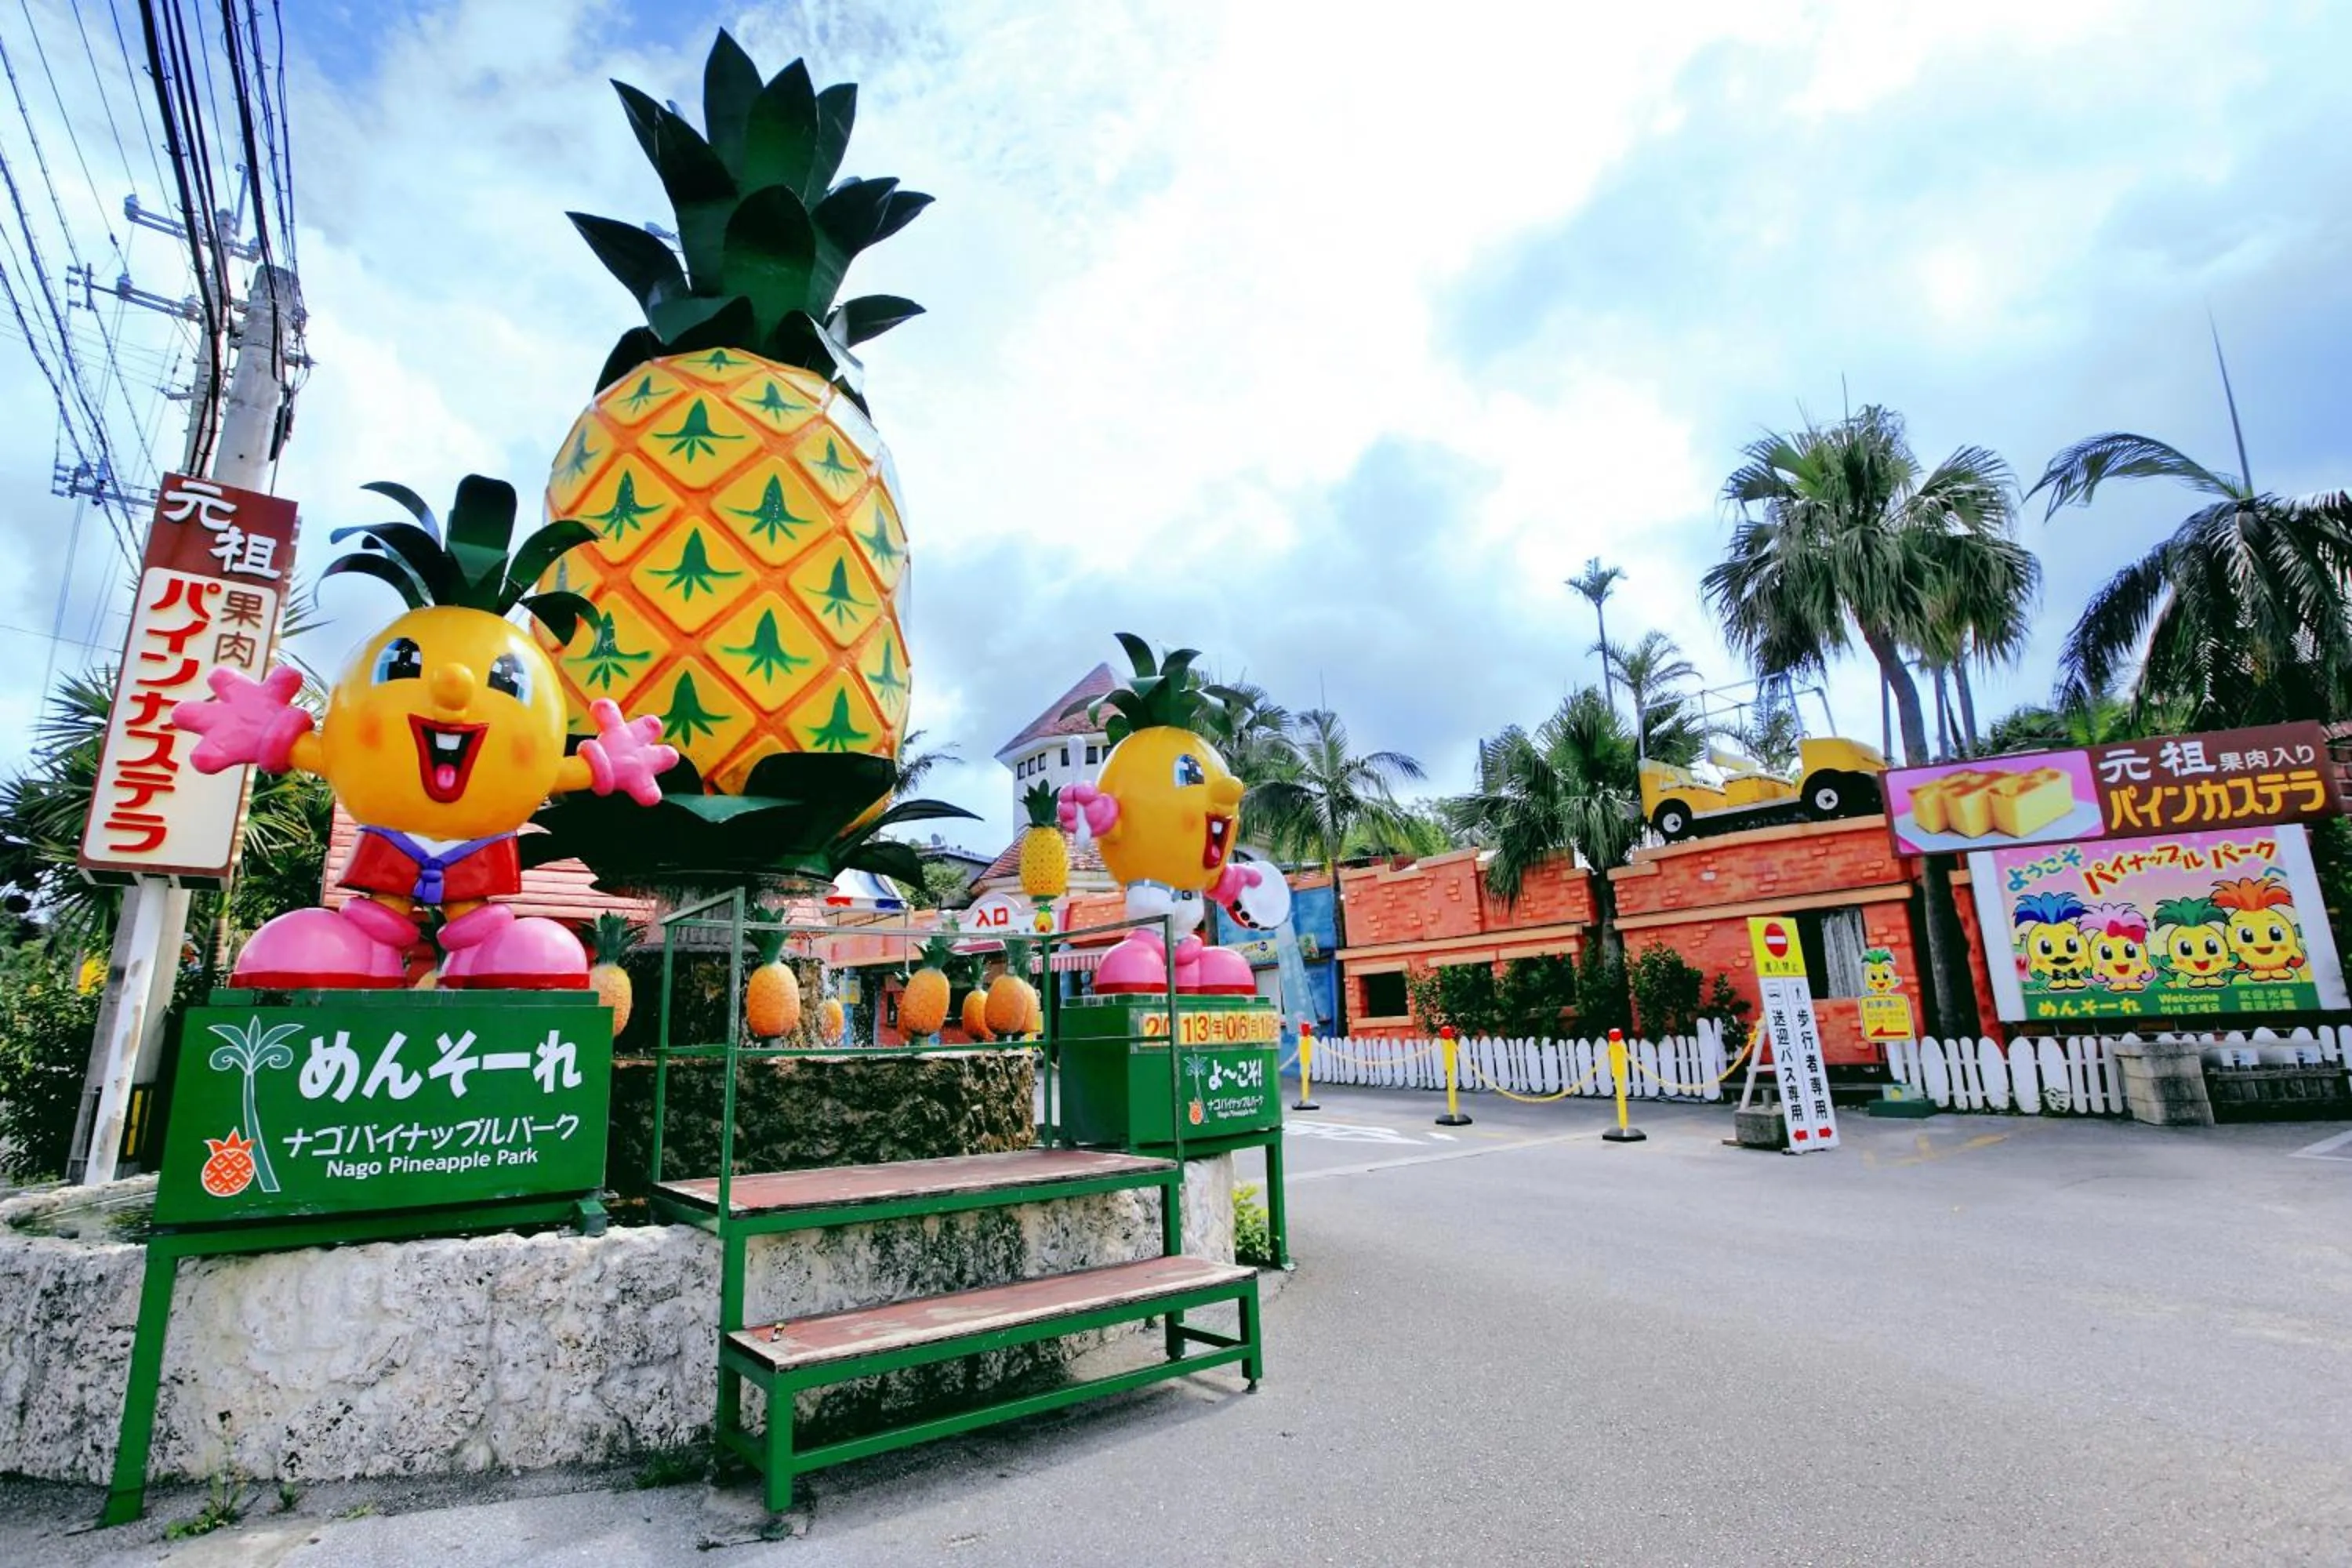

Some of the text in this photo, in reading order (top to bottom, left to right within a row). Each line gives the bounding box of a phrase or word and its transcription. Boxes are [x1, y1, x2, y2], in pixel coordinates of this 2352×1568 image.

[163, 481, 282, 581] 元祖
[104, 578, 222, 853] パインカステラ
[2098, 741, 2317, 785] 元祖 果肉入り
[2109, 770, 2327, 831] パインカステラ
[2006, 846, 2083, 893] ようこそ
[976, 907, 1009, 927] 入口
[2038, 997, 2143, 1018] めんそーれ
[2158, 993, 2220, 1004] Welcome
[299, 1029, 583, 1103] めんそーれ
[1771, 1009, 1805, 1122] 送迎バス専用
[1797, 1009, 1828, 1120] 歩行者専用
[325, 1146, 539, 1180] Nago Pineapple Park
